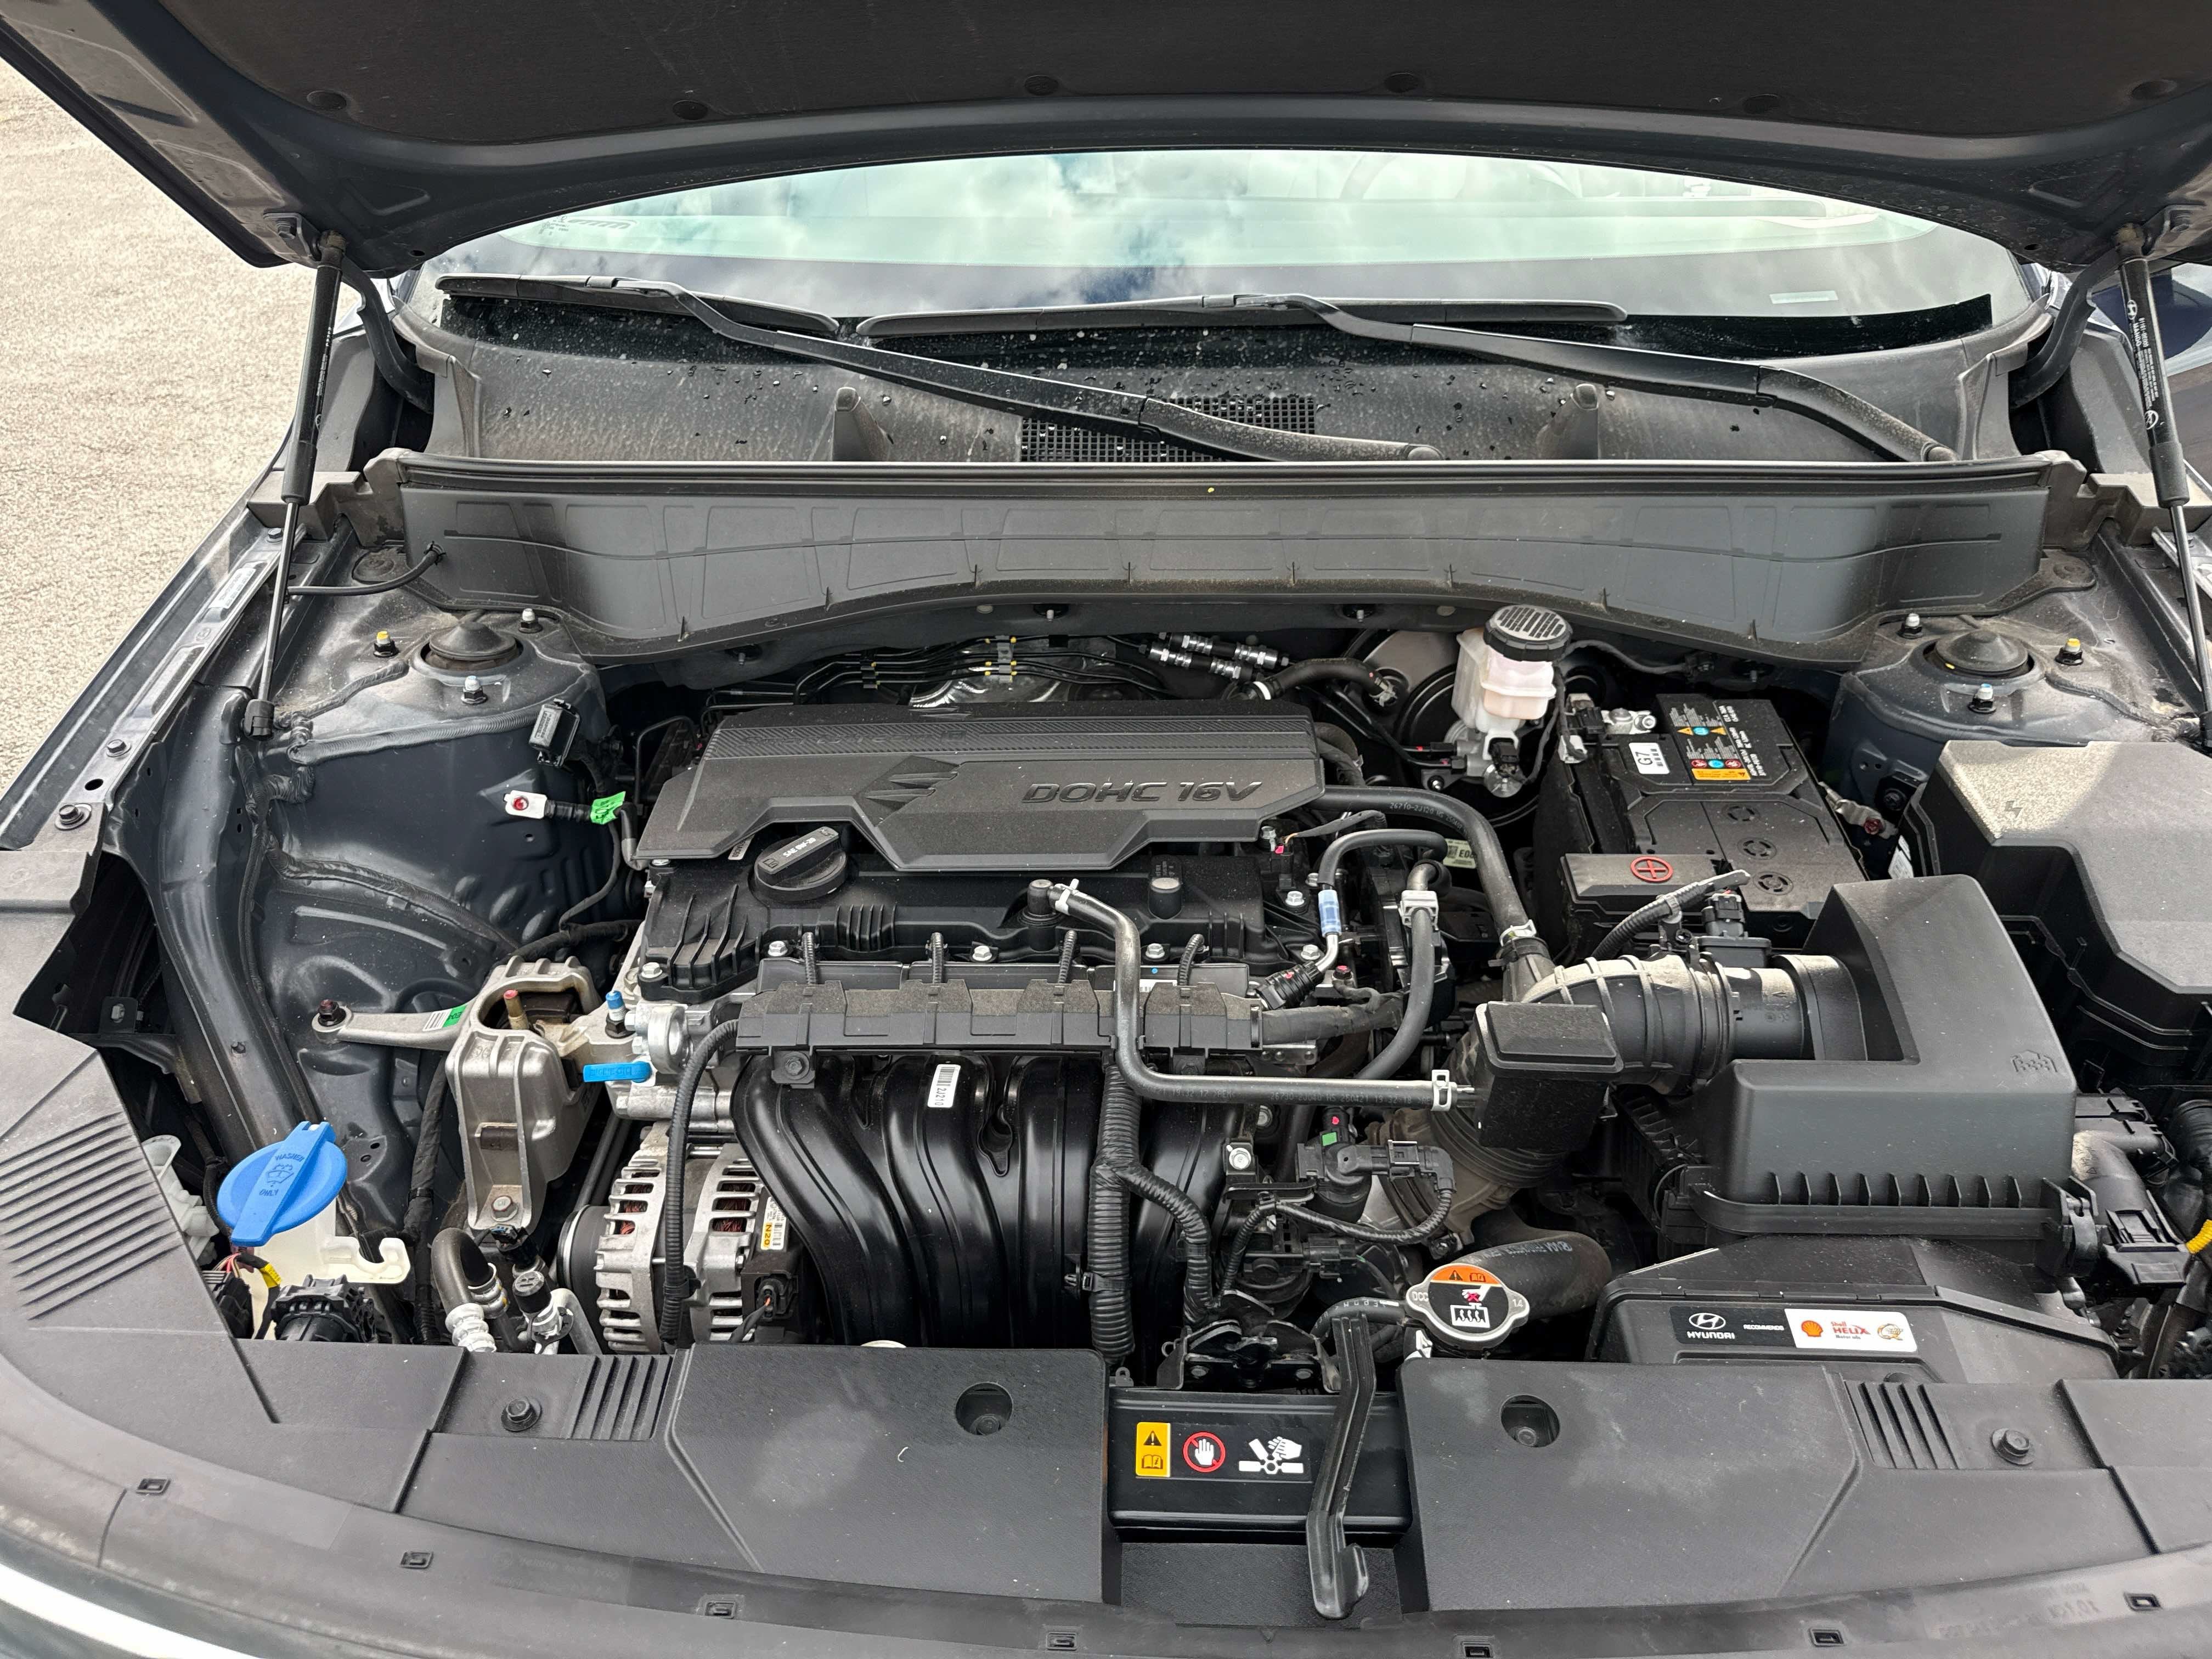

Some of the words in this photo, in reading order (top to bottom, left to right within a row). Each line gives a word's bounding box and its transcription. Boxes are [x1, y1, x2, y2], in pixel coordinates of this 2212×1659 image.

[1637, 751, 1652, 766] G7
[1022, 781, 1167, 804] DOHC
[1177, 781, 1263, 802] 16V
[783, 848, 798, 857] SAE
[275, 1153, 305, 1163] WASHER
[1686, 1330, 1736, 1339] HYUNDAI
[1832, 1325, 1869, 1335] HELIX
